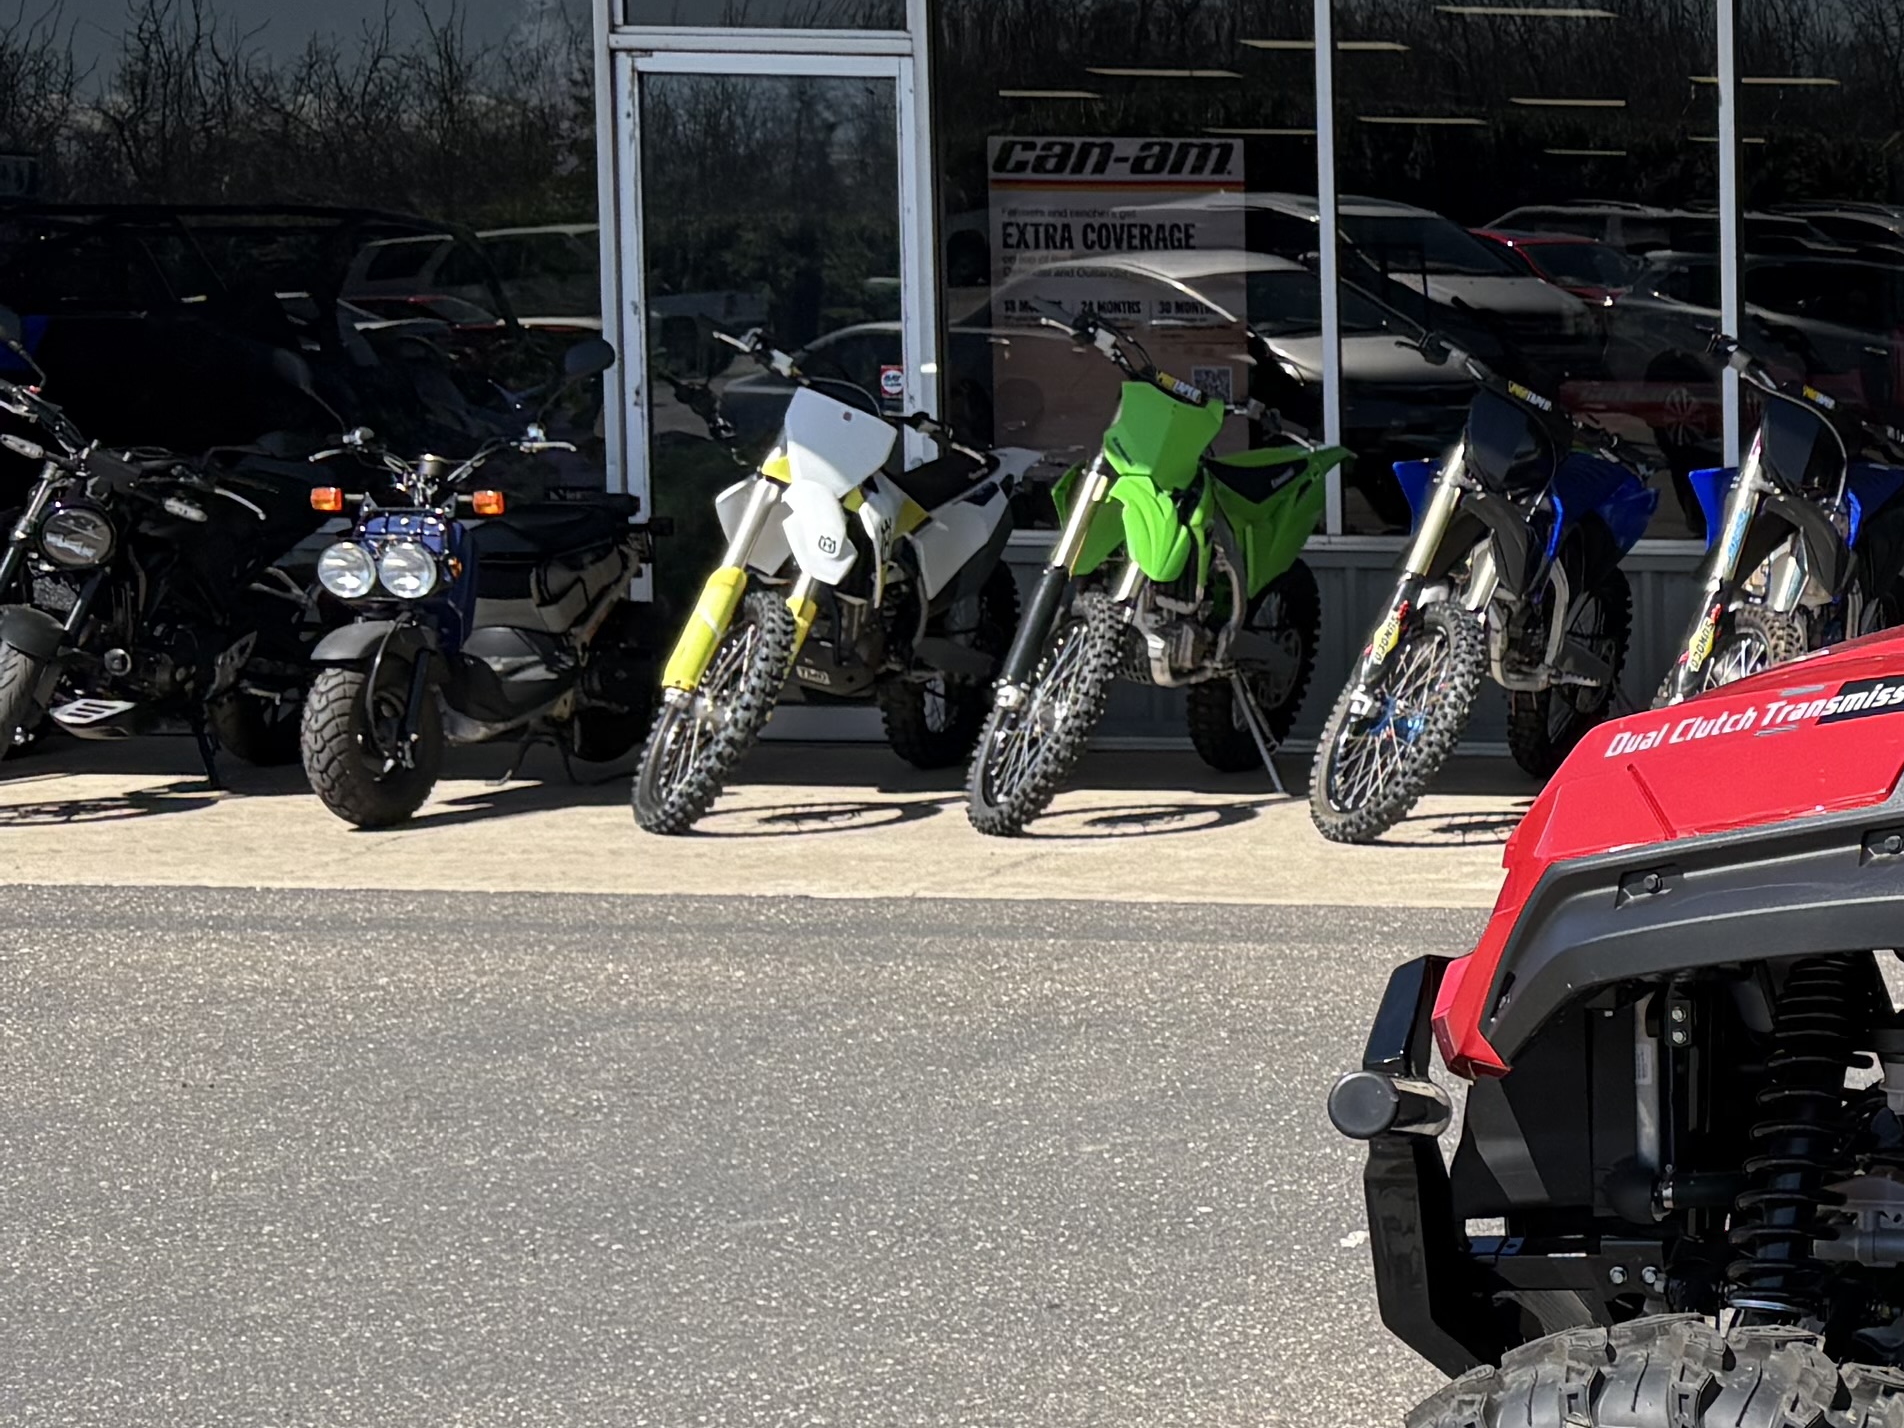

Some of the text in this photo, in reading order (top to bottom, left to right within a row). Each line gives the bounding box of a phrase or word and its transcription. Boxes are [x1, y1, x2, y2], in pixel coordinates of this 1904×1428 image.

[1002, 223, 1197, 250] EXTRA COVERAGE
[1097, 300, 1141, 314] MONTHS
[1604, 723, 1662, 758] Dual
[1669, 705, 1758, 744] Clutch
